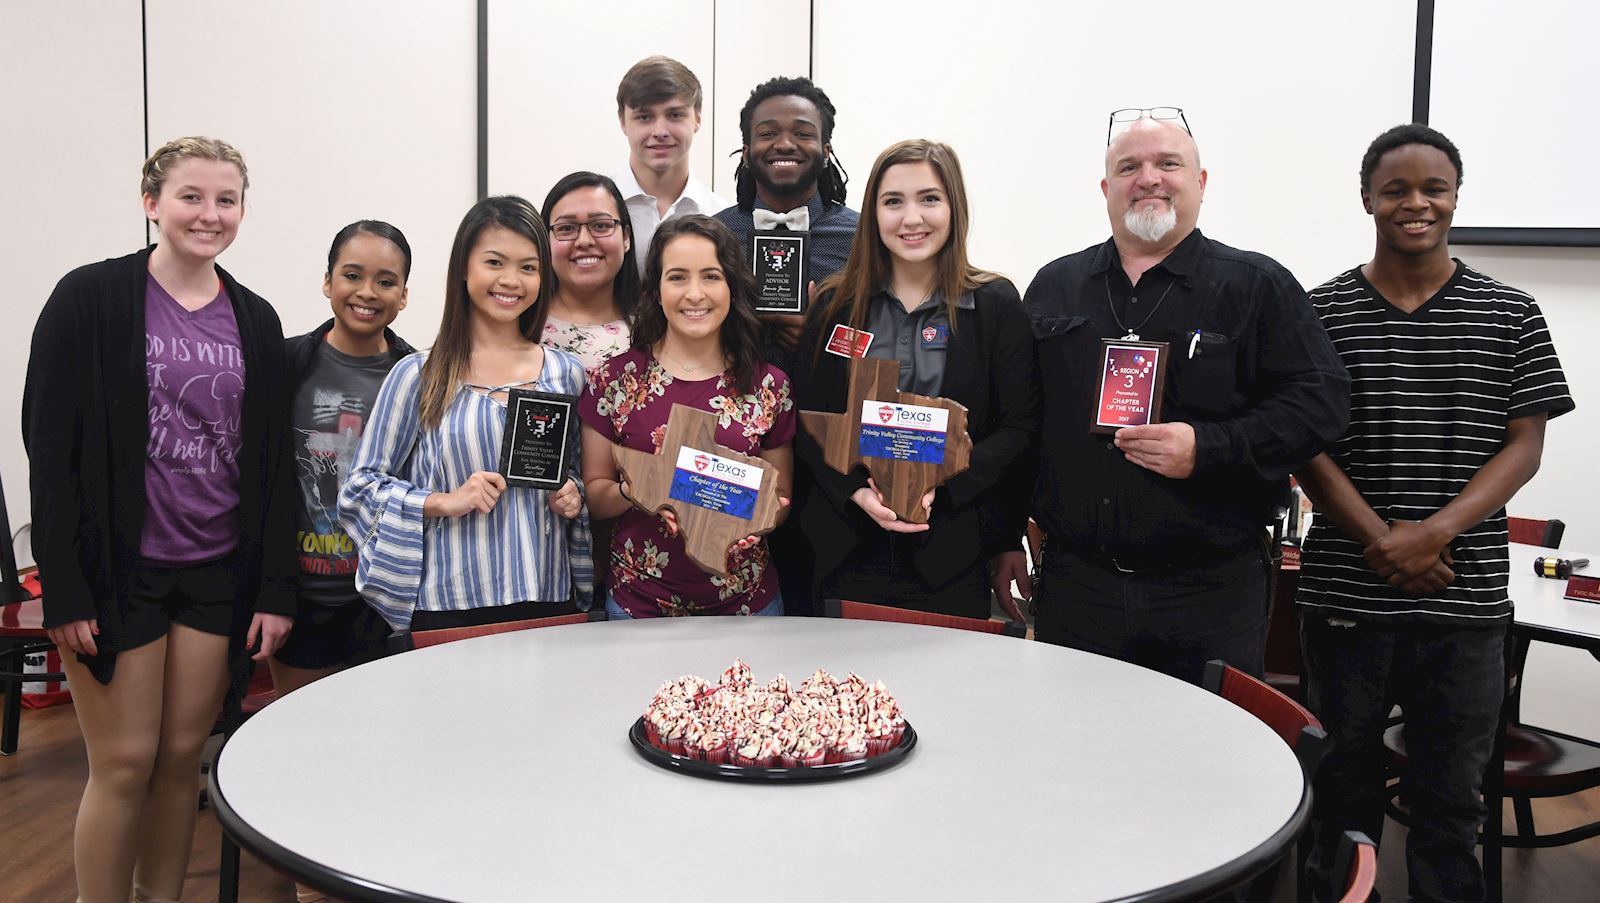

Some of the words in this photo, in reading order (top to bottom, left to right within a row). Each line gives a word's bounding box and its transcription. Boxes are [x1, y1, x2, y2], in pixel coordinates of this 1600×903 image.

[772, 255, 783, 267] 3
[172, 337, 191, 361] IS
[1120, 367, 1139, 375] REGION
[1123, 375, 1134, 388] 3
[1112, 397, 1140, 405] CHAPTER
[895, 406, 932, 423] Texas
[534, 420, 546, 433] 3
[862, 429, 880, 438] Trinity
[880, 430, 896, 439] Valley
[896, 433, 926, 442] Community
[926, 436, 945, 444] College
[172, 434, 207, 460] not
[711, 457, 747, 479] Texas
[689, 475, 712, 486] Chapter
[712, 481, 720, 489] of
[719, 483, 728, 491] the
[729, 486, 743, 495] Year
[300, 556, 331, 575] OUTH
